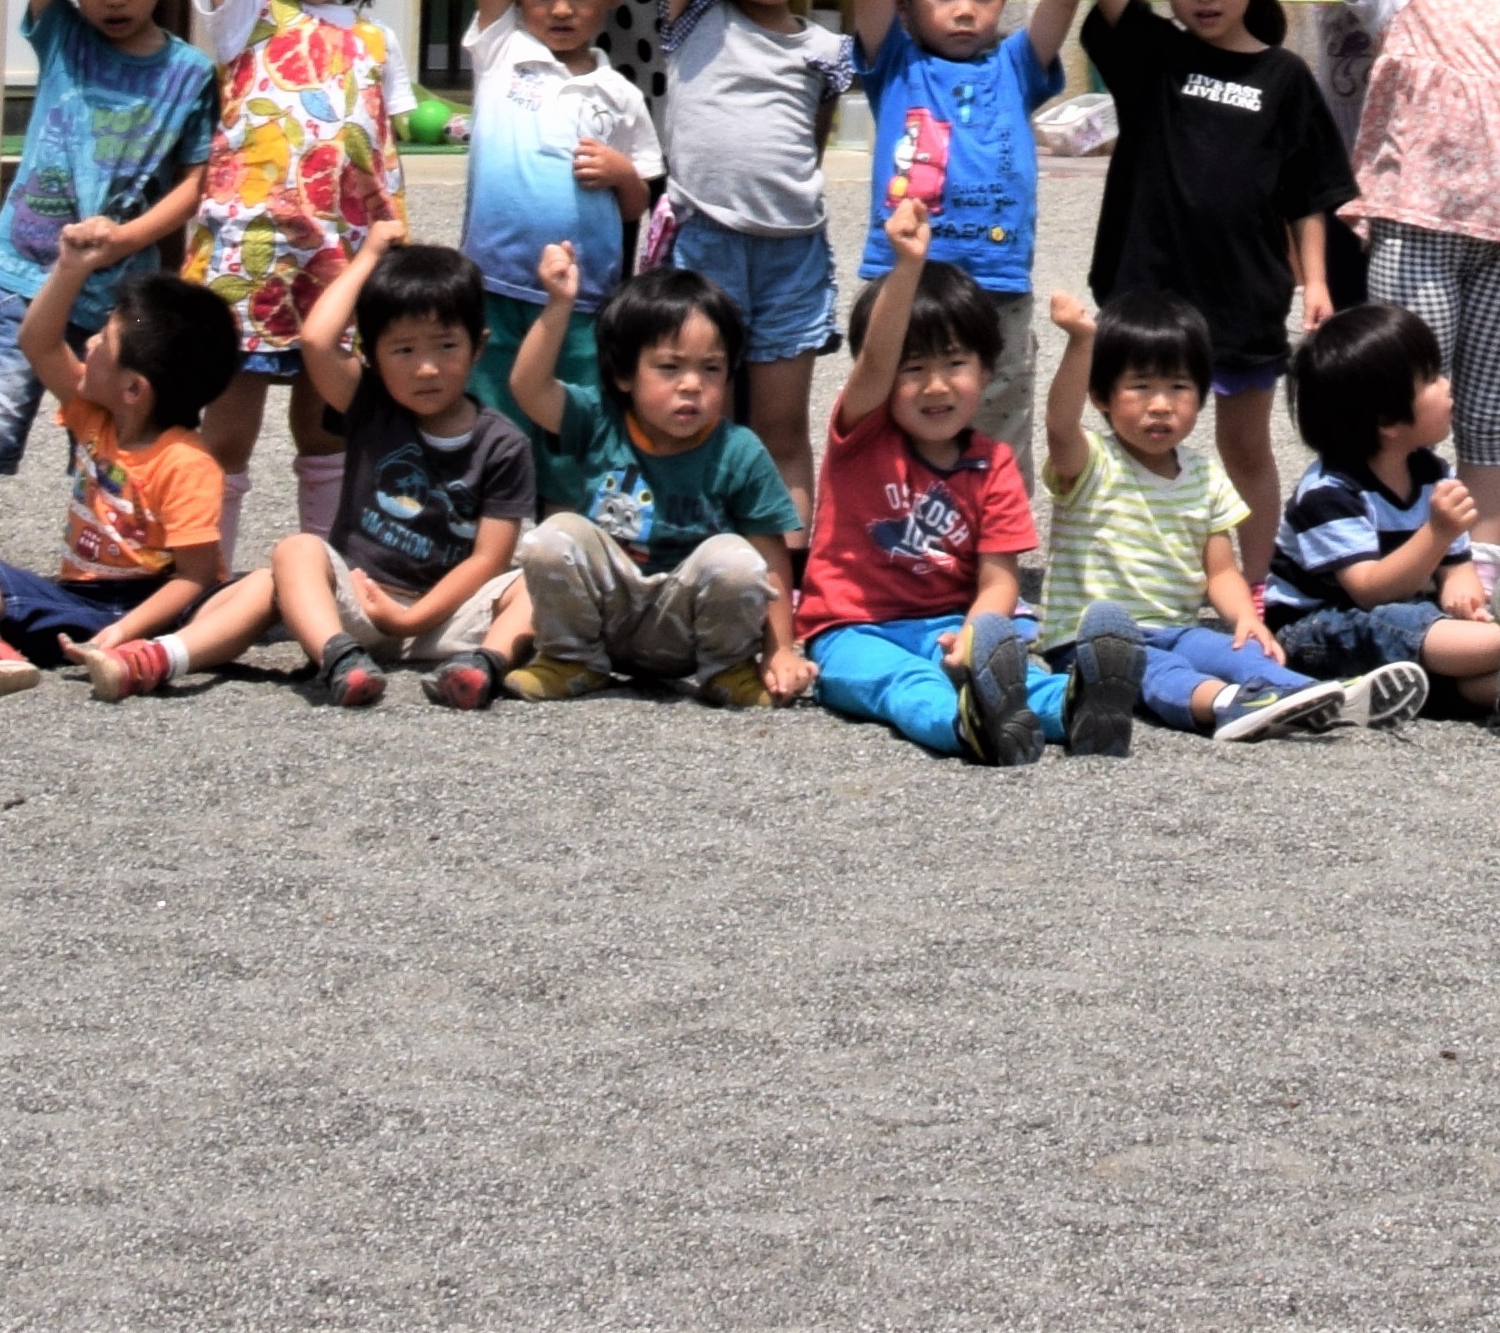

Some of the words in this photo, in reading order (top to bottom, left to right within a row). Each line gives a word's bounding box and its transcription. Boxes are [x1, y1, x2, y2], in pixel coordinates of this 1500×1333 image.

[1181, 83, 1221, 102] LIVE
[1222, 92, 1263, 113] LONG
[1187, 72, 1223, 90] LIVE
[1225, 81, 1263, 100] FAST
